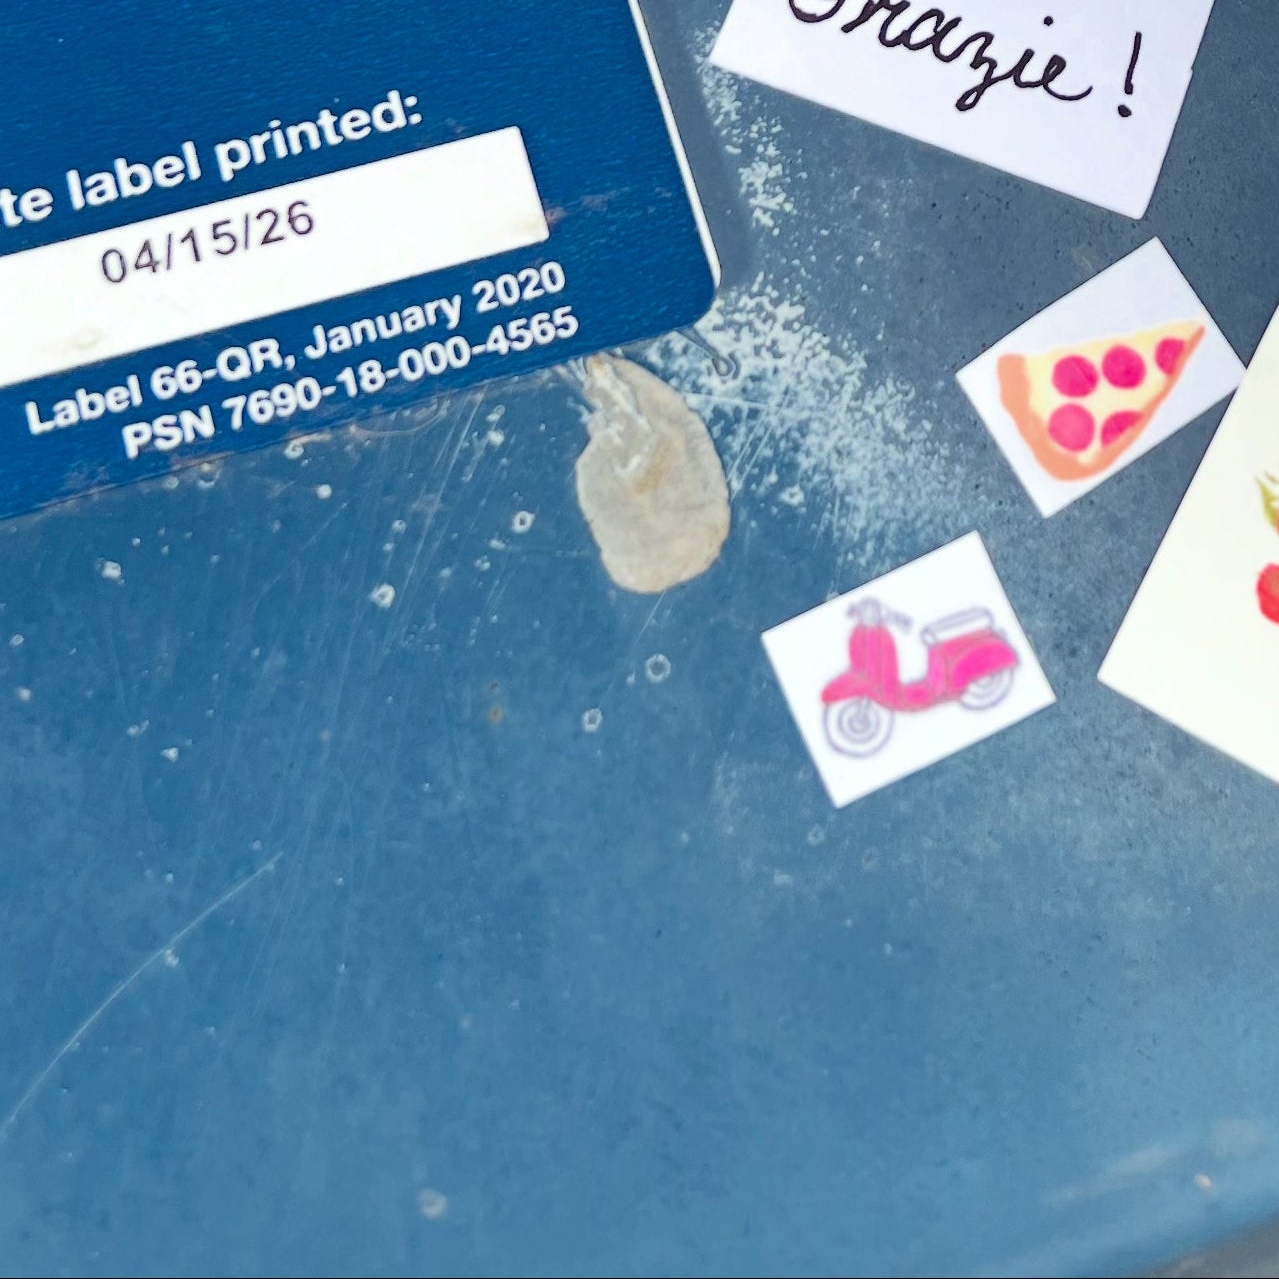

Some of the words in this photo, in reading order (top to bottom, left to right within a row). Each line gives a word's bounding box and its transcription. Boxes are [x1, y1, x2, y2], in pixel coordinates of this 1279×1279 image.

[0, 187, 54, 228] te
[66, 140, 202, 211] label
[215, 90, 423, 180] printed:
[101, 199, 316, 284] 04/15/26
[26, 373, 143, 436] Label
[150, 338, 297, 402] 66-QR,
[305, 299, 463, 362] January
[471, 260, 567, 313] 2020
[121, 403, 216, 459] PSN
[226, 305, 580, 426] 7690-18-000-4565
